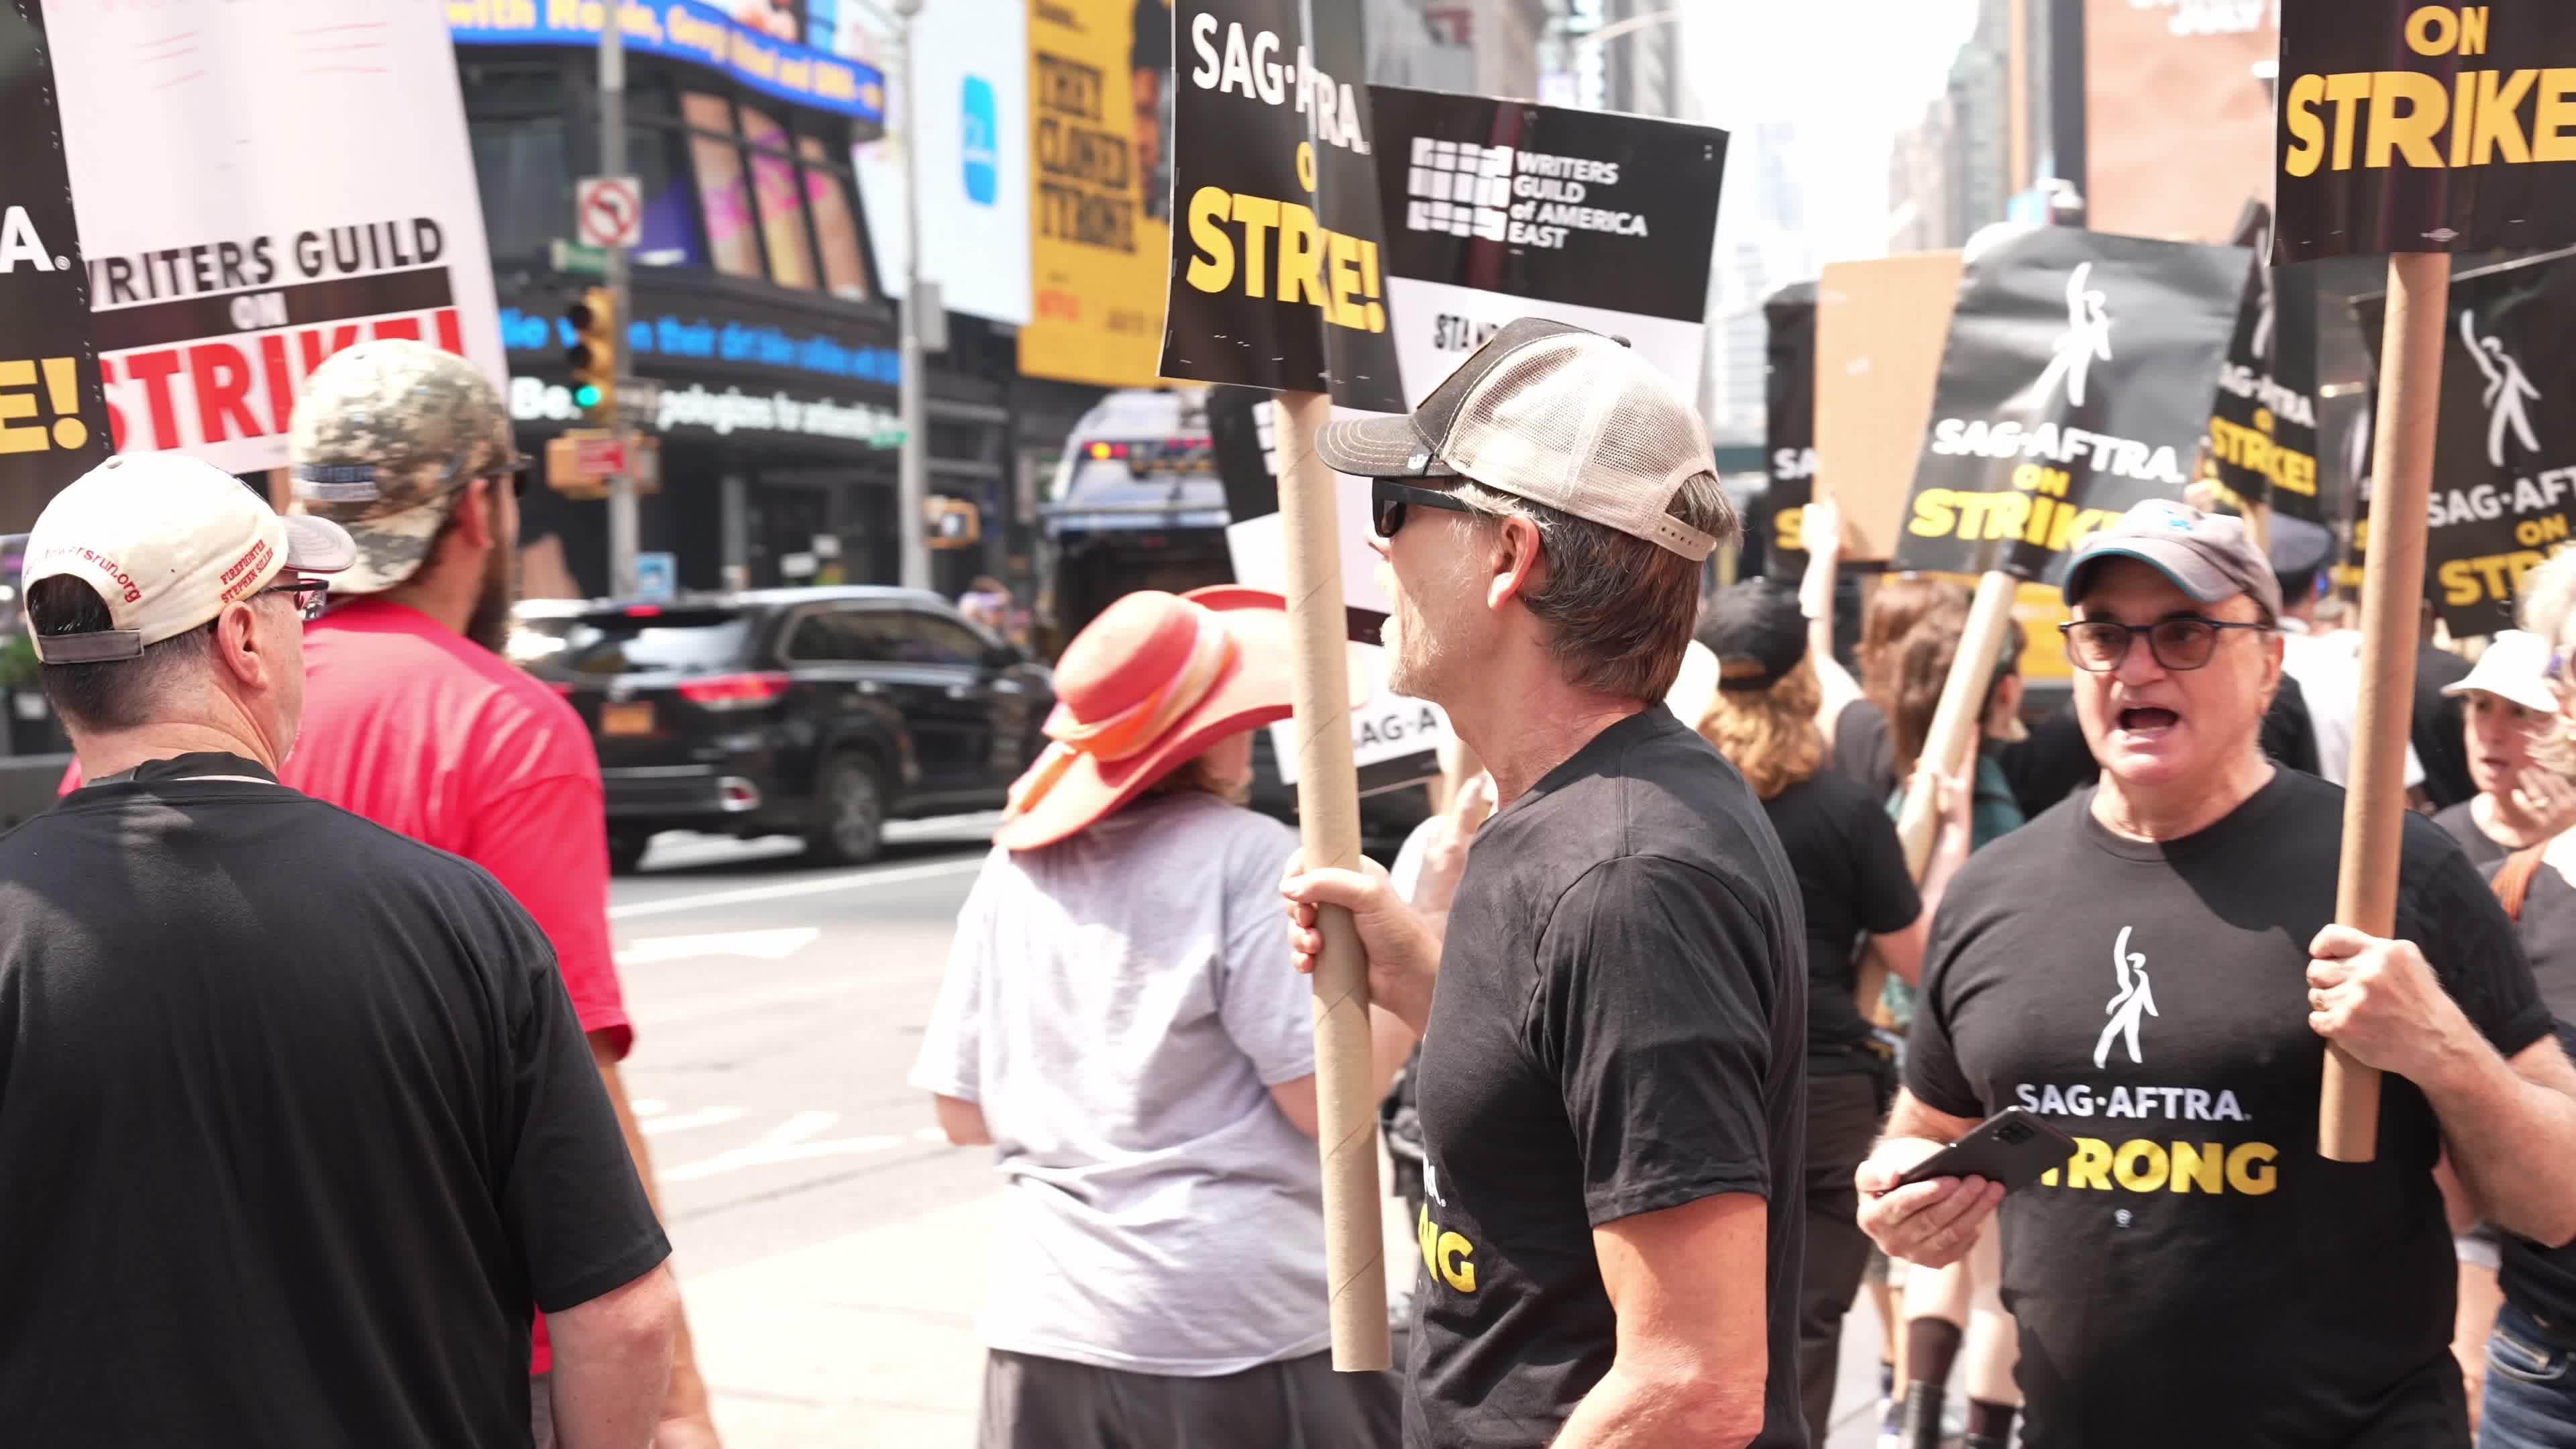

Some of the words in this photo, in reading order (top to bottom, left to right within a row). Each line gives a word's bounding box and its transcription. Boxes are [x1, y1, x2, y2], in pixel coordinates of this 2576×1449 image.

[2404, 5, 2489, 56] ON
[2285, 68, 2576, 177] STRIKE
[1296, 142, 1318, 193] O
[1516, 151, 1620, 185] WRITERS
[1513, 174, 1586, 203] GUILD
[1507, 221, 1570, 249] EAST
[1510, 201, 1538, 221] of
[1536, 202, 1648, 237] AMERICA
[294, 218, 444, 277] GUILD
[2012, 463, 2071, 498] ON
[2517, 513, 2569, 547] ON
